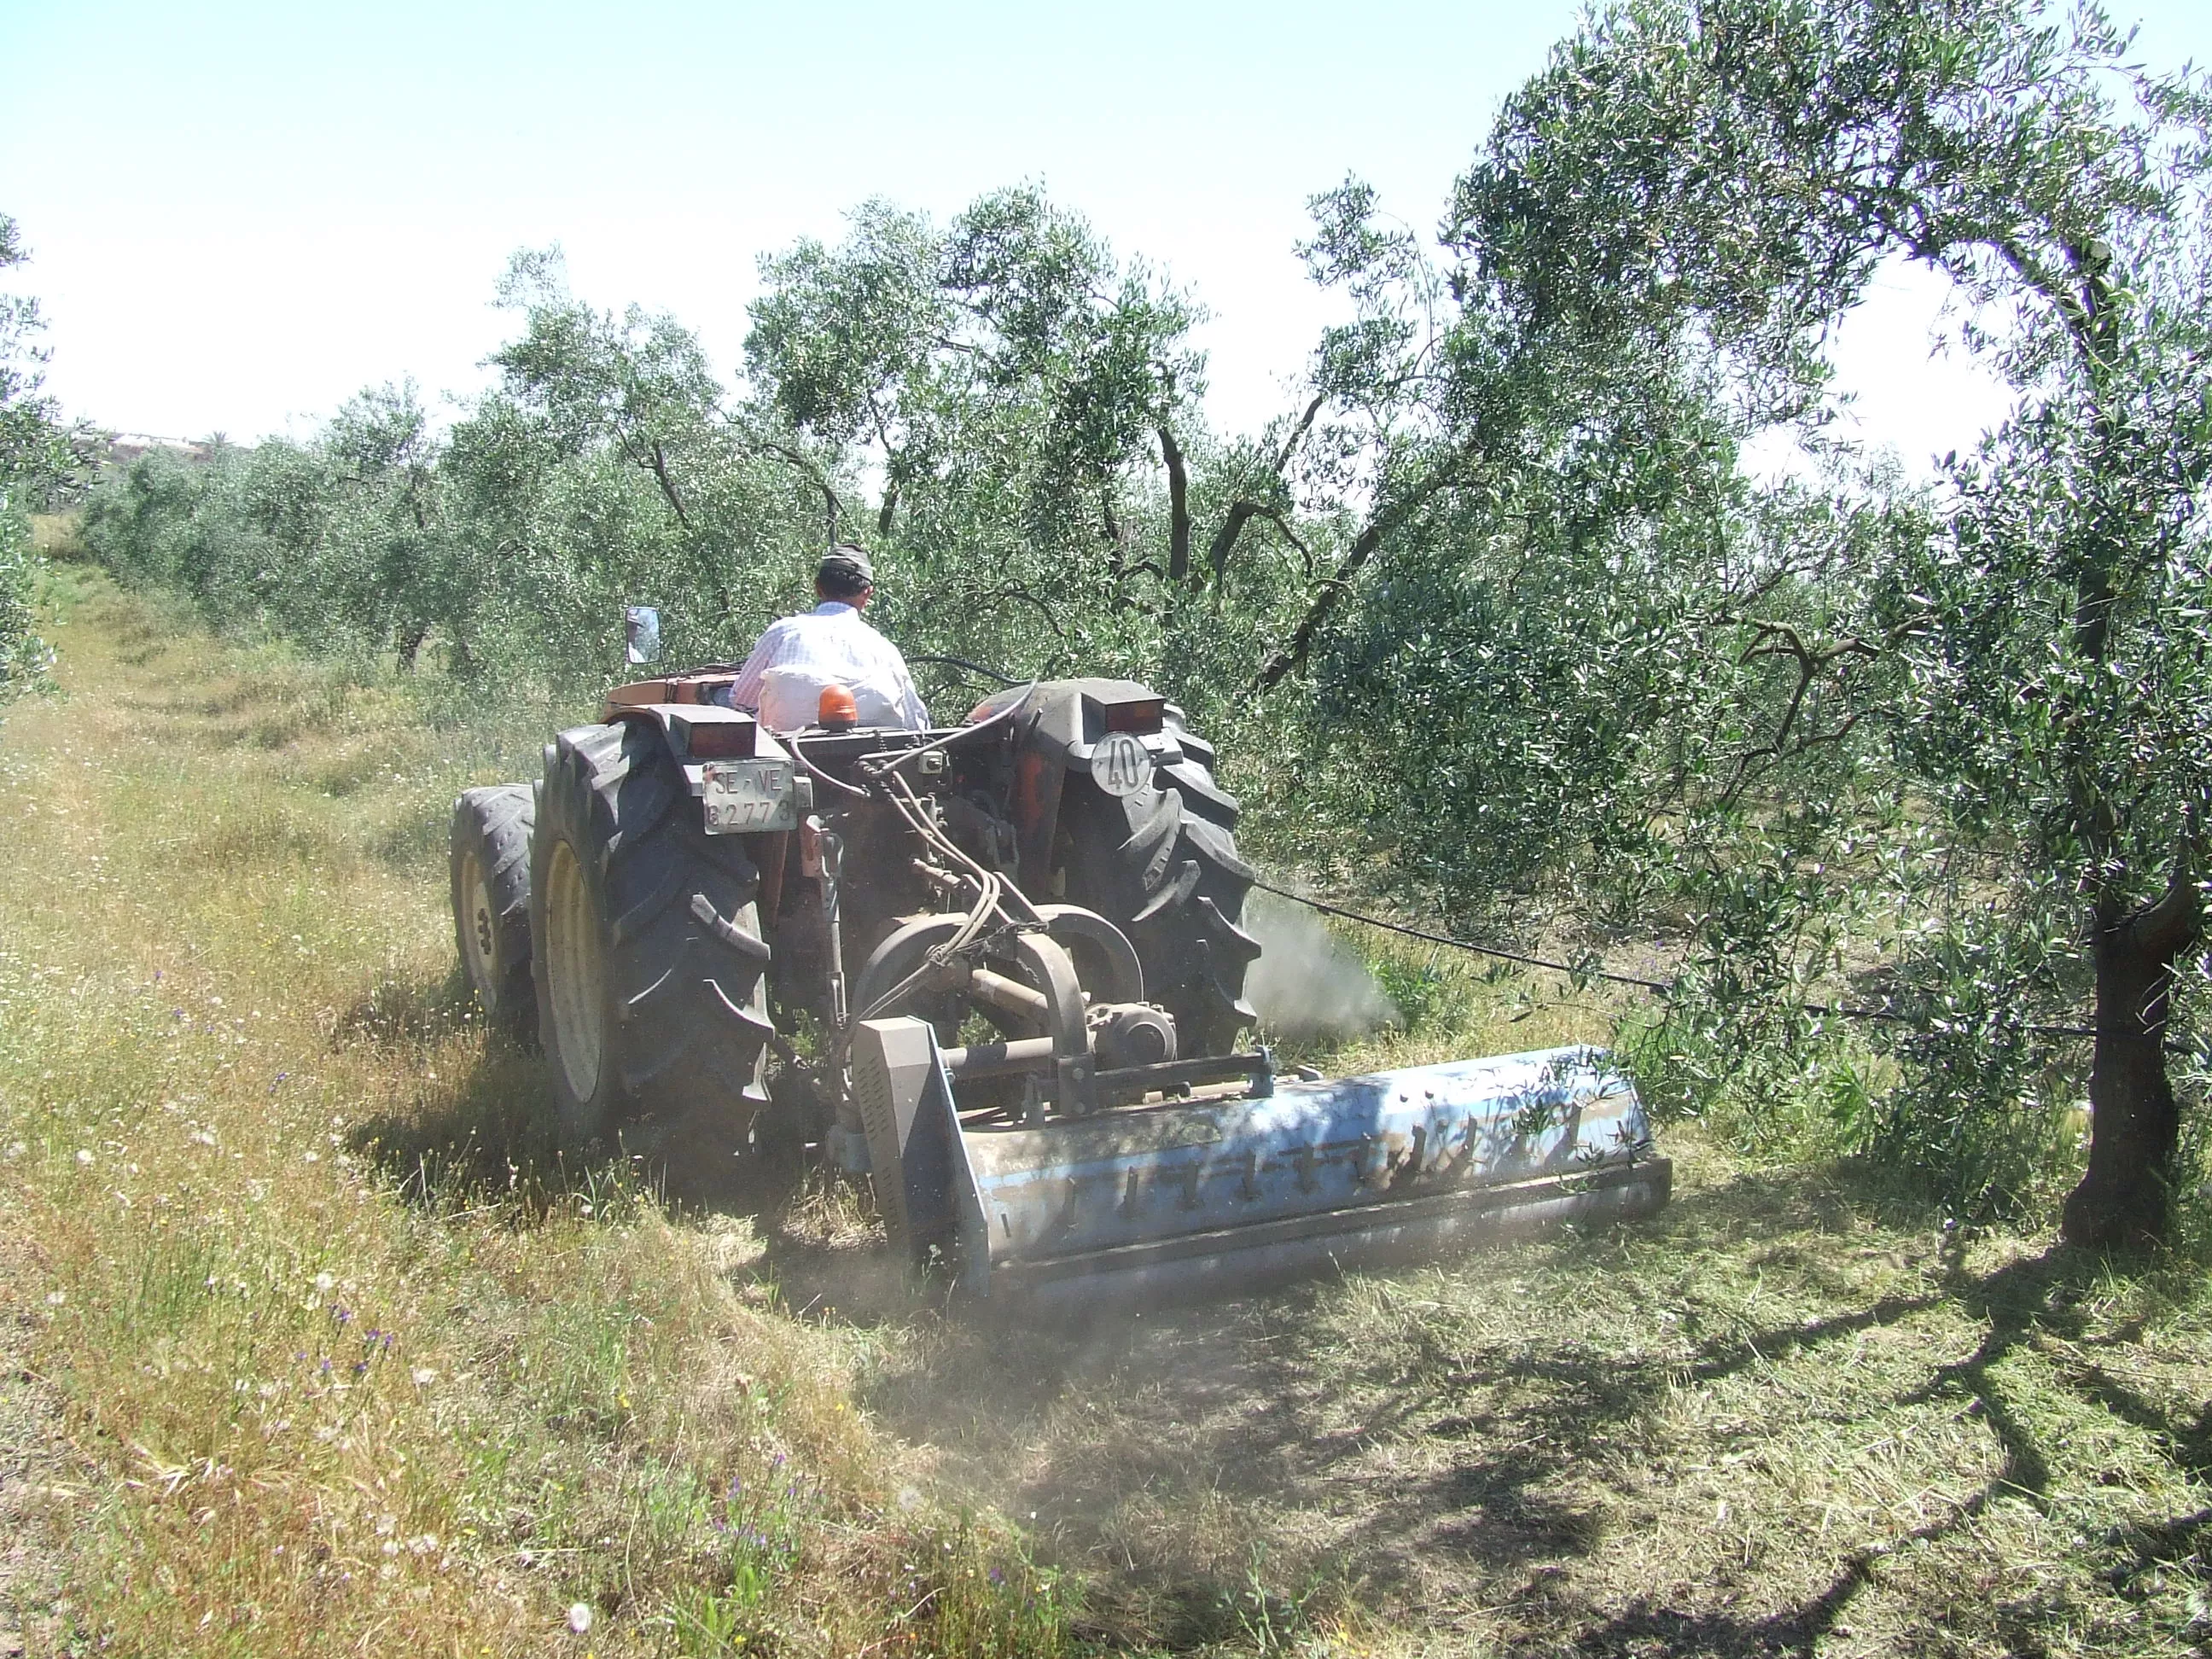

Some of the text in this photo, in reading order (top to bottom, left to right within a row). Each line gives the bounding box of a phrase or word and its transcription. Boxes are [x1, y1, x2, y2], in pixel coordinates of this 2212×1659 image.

[714, 770, 738, 795] SE
[757, 768, 783, 792] VE
[1108, 738, 1138, 789] 40
